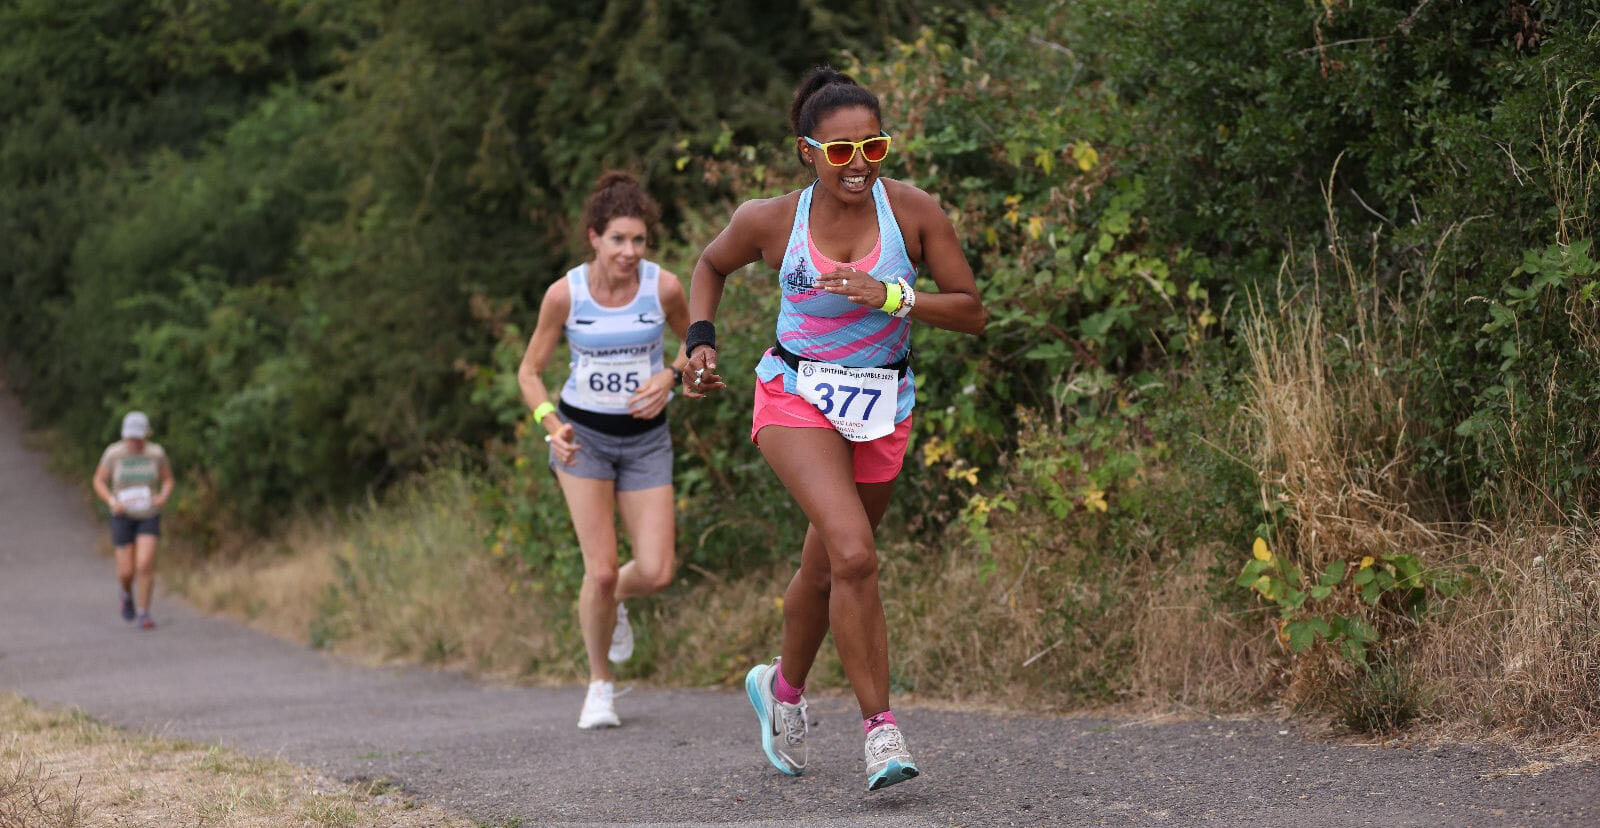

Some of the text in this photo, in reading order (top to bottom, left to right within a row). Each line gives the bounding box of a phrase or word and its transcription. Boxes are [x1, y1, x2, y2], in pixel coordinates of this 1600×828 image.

[589, 371, 640, 393] 685
[820, 367, 848, 376] SPITFIRE
[813, 382, 882, 420] 377
